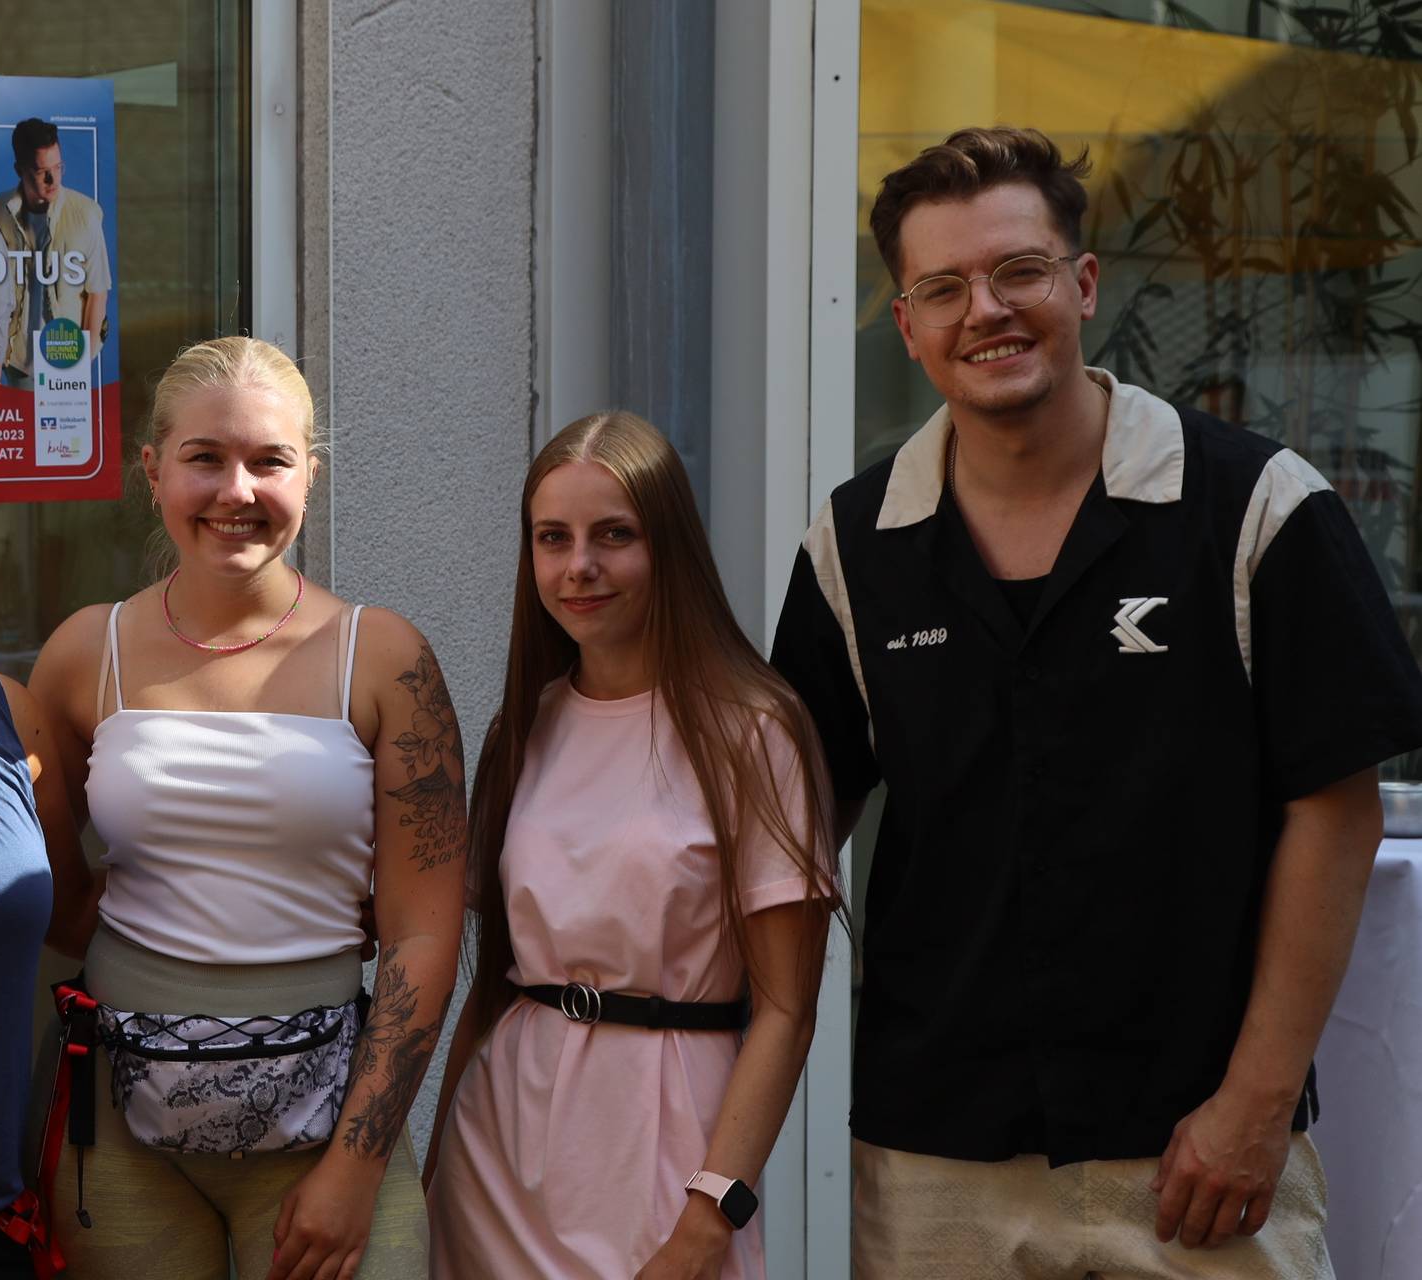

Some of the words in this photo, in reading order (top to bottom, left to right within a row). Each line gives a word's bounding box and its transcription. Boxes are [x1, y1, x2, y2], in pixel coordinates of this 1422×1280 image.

[46, 352, 78, 361] FESTIVAL
[48, 378, 87, 391] Lünen
[887, 634, 908, 650] est.
[912, 627, 948, 647] 1989
